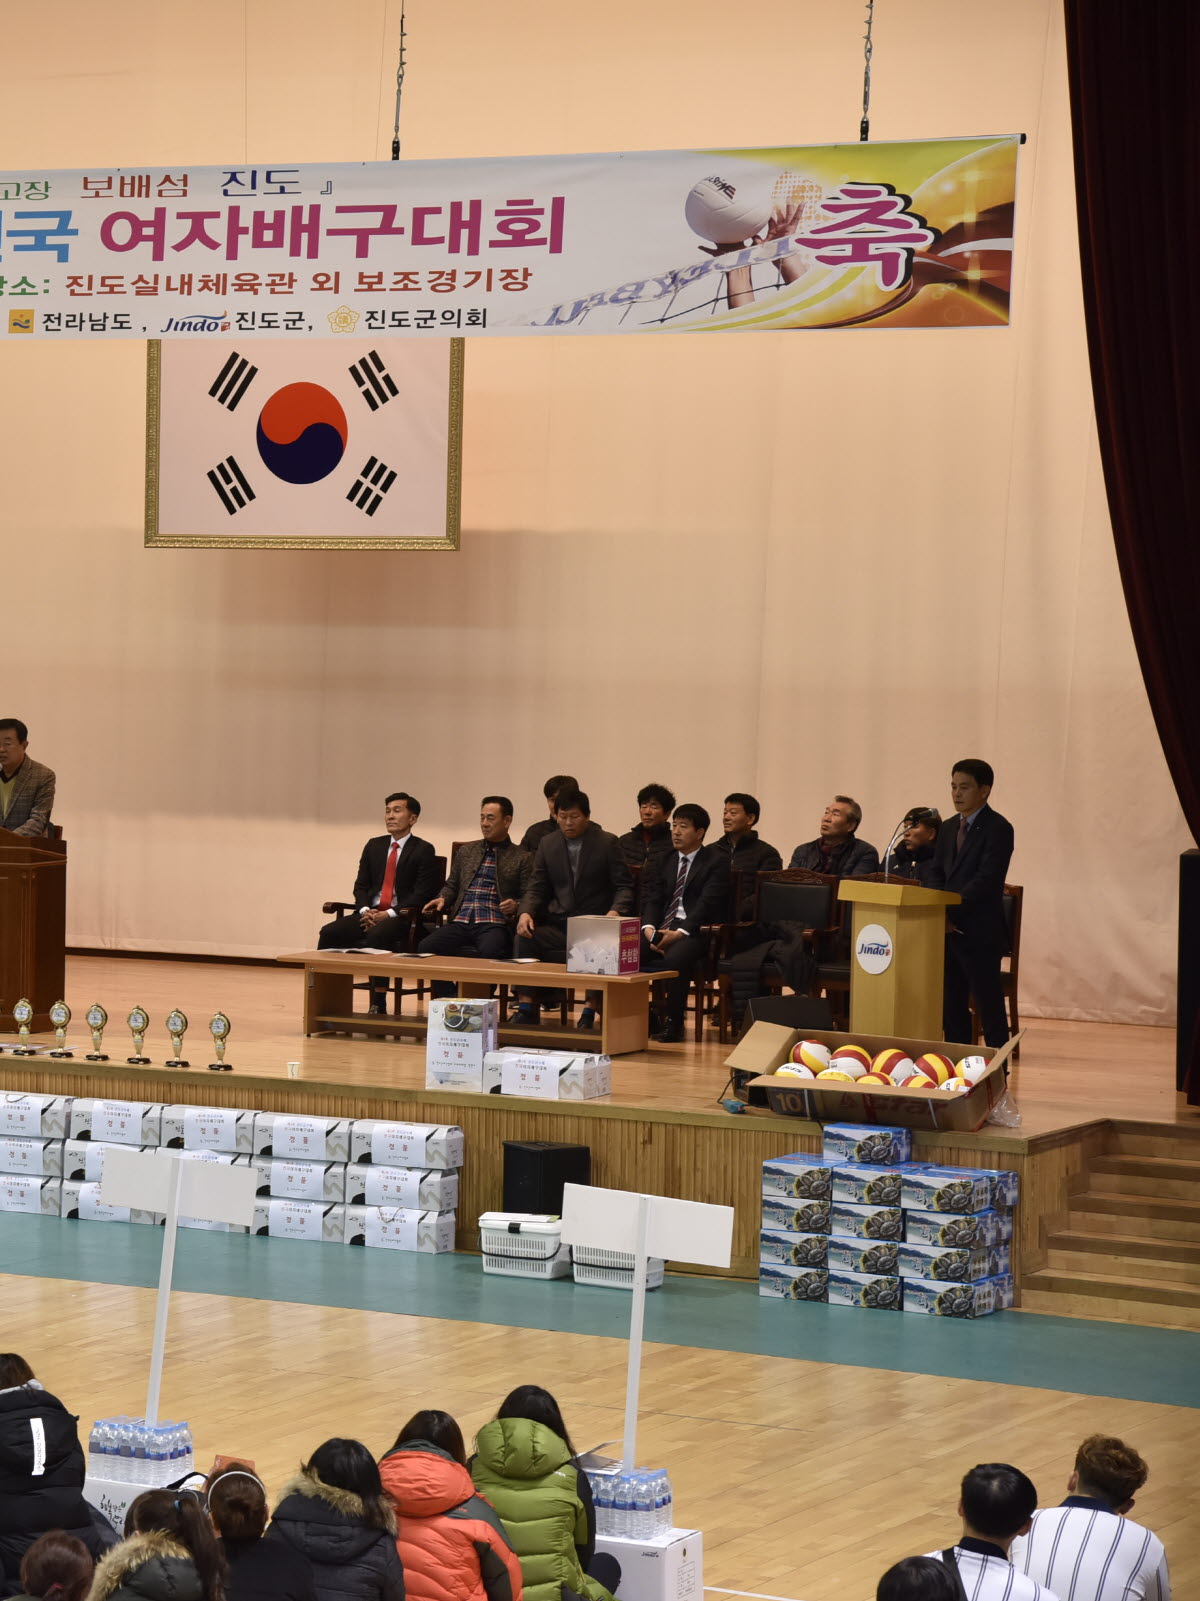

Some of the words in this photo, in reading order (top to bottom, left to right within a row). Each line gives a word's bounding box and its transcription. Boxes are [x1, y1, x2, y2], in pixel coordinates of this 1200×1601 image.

[80, 169, 189, 199] 보배섬
[220, 169, 302, 197] 진도
[99, 196, 566, 262] 여자배구대회
[795, 187, 933, 290] 축
[64, 271, 298, 297] 진도실내체육관
[309, 270, 341, 295] 외
[353, 266, 534, 294] 보조경기장
[160, 316, 220, 333] Jindo
[234, 310, 313, 332] 진도군,
[364, 307, 487, 330] 진도군의회
[858, 943, 885, 956] Jindo
